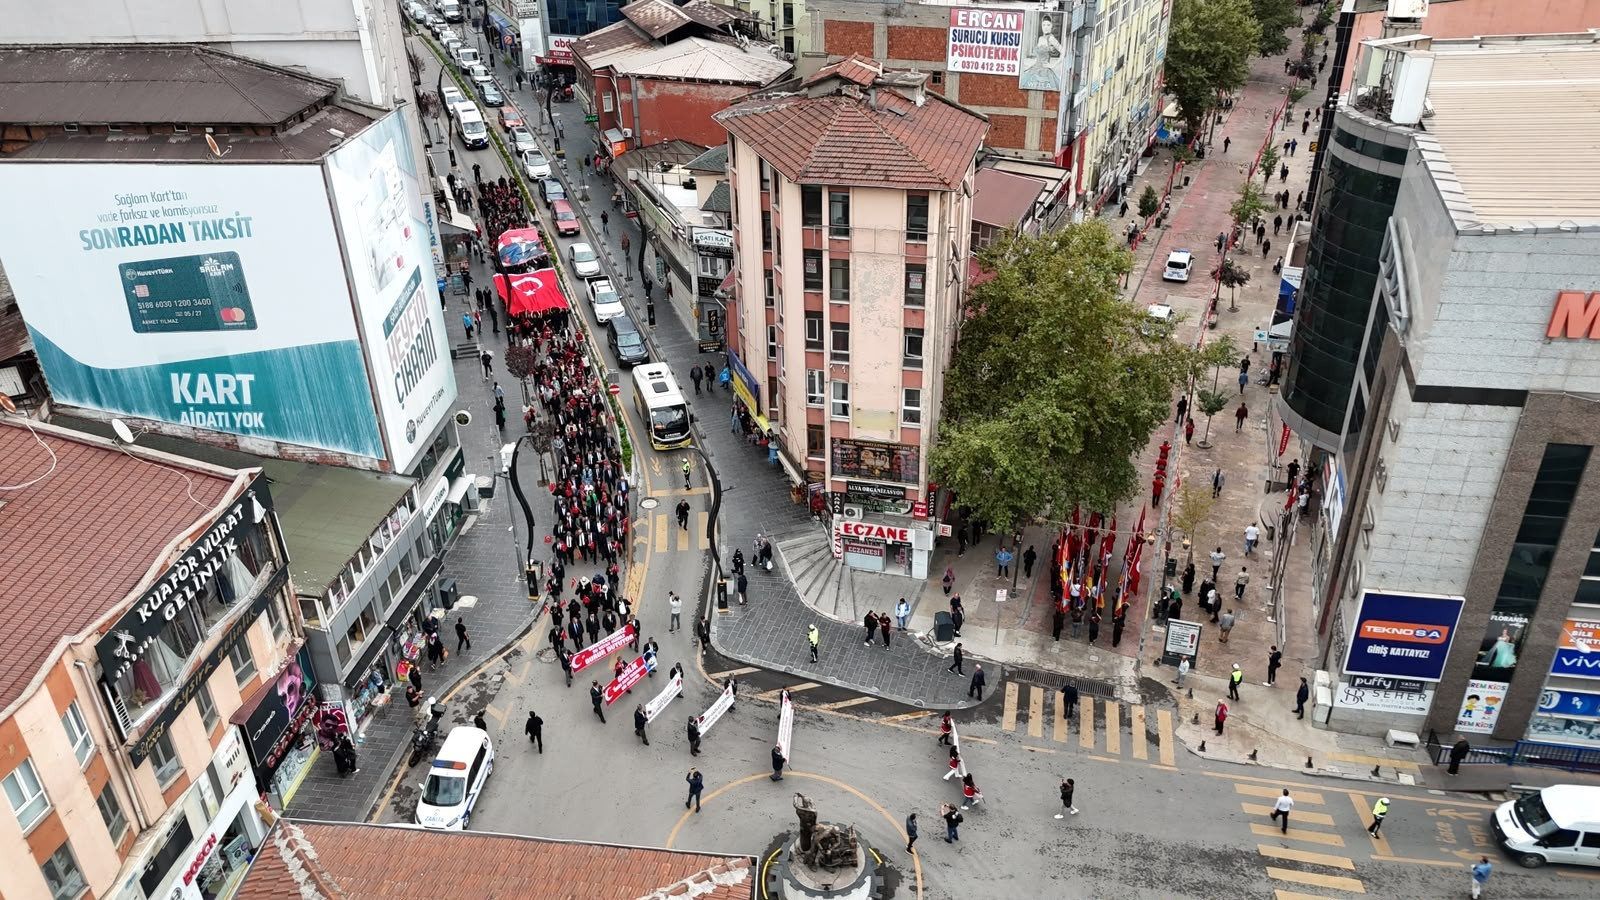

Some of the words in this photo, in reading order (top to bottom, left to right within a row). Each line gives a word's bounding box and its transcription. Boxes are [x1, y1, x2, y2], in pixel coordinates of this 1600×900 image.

[957, 10, 1017, 29] ERCAN
[991, 32, 1020, 47] KURSU
[962, 60, 979, 70] 0370
[981, 62, 994, 71] 412
[996, 63, 1005, 72] 25
[1007, 63, 1016, 72] 53
[115, 193, 149, 207] Sağlam
[150, 190, 188, 203] Kart'tan
[119, 208, 148, 223] farksız
[149, 209, 160, 219] ve
[162, 204, 218, 218] komisyonsuz
[79, 221, 186, 251] SONRADAN
[188, 211, 252, 242] TAKSİT
[137, 301, 154, 309] 5188
[155, 300, 172, 308] 6030
[174, 299, 191, 307] 1200
[193, 298, 211, 306] 3400
[394, 317, 437, 411] ÇIKARIN
[170, 372, 255, 405] KART
[180, 406, 230, 428] AİDATI
[232, 412, 265, 428] YOK
[843, 523, 908, 541] ECZANE
[137, 555, 199, 623] KUAFÖR
[197, 503, 243, 560] MURAT
[162, 537, 238, 621] GELİNLİK
[1365, 625, 1440, 638] TEKNOSA
[1367, 644, 1388, 657] GİRİŞ
[1372, 690, 1427, 701] SEHER
[183, 831, 217, 886] BOSCH
